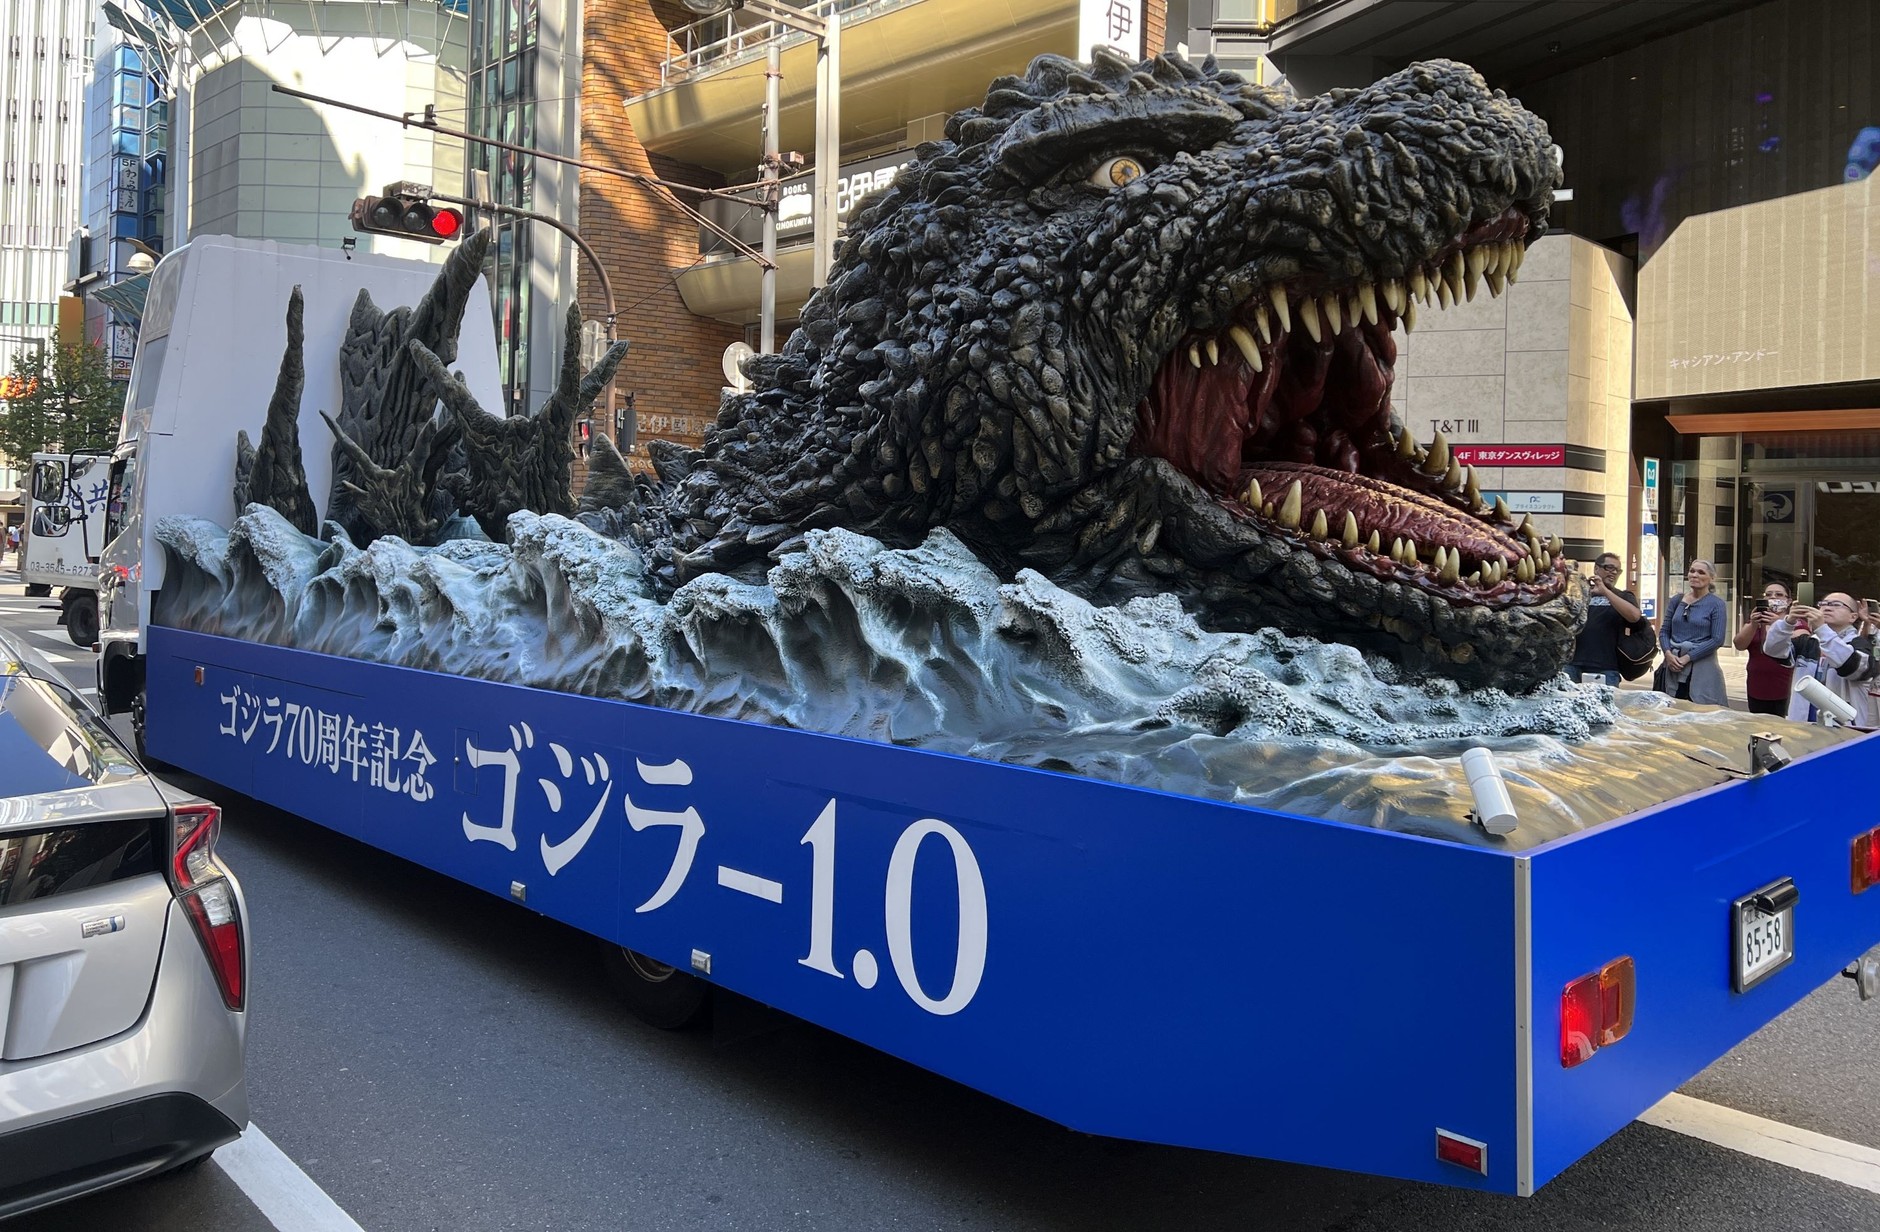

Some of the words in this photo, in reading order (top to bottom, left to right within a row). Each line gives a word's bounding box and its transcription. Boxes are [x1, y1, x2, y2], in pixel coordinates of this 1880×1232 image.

[1106, 0, 1132, 59] 伊
[783, 183, 807, 196] BOOKS
[1670, 349, 1779, 370] キャシアン・アンドー
[1430, 419, 1464, 433] T&T
[1458, 452, 1471, 460] 4F
[1478, 451, 1560, 461] 東京ダンスヴィレッジ
[218, 685, 437, 802] ゴジラ70周年記念
[1746, 917, 1781, 967] 85-58
